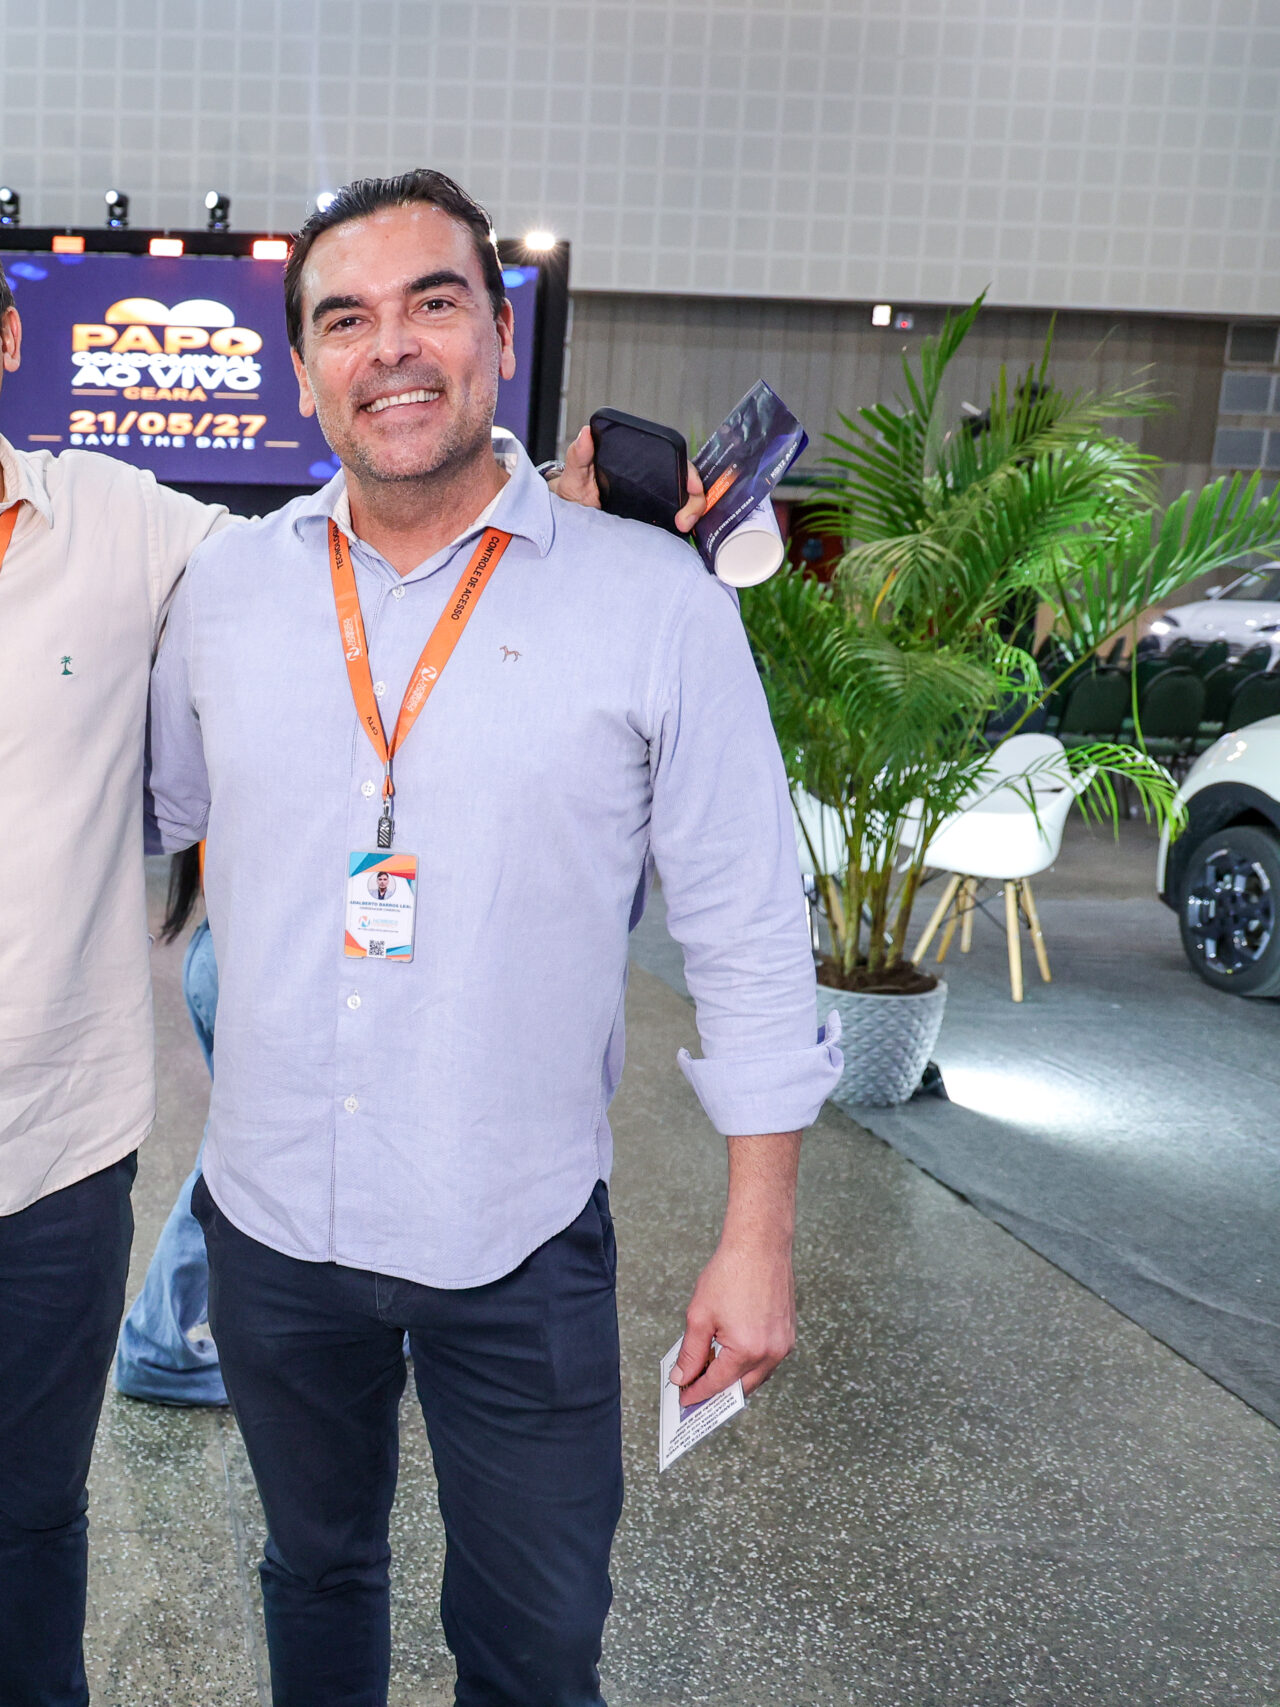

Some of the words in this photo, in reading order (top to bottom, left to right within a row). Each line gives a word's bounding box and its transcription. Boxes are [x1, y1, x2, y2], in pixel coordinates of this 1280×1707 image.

[71, 322, 263, 357] PAPO
[71, 364, 141, 388] AO
[148, 366, 262, 391] VIVO
[122, 385, 208, 402] CEARÁ
[69, 410, 267, 437] 21/05/27
[70, 433, 130, 447] SAVE
[140, 434, 186, 448] THE
[196, 436, 256, 450] DATE
[473, 536, 500, 577] CONTROLE
[466, 576, 479, 589] DE
[451, 588, 472, 621] ACESSO
